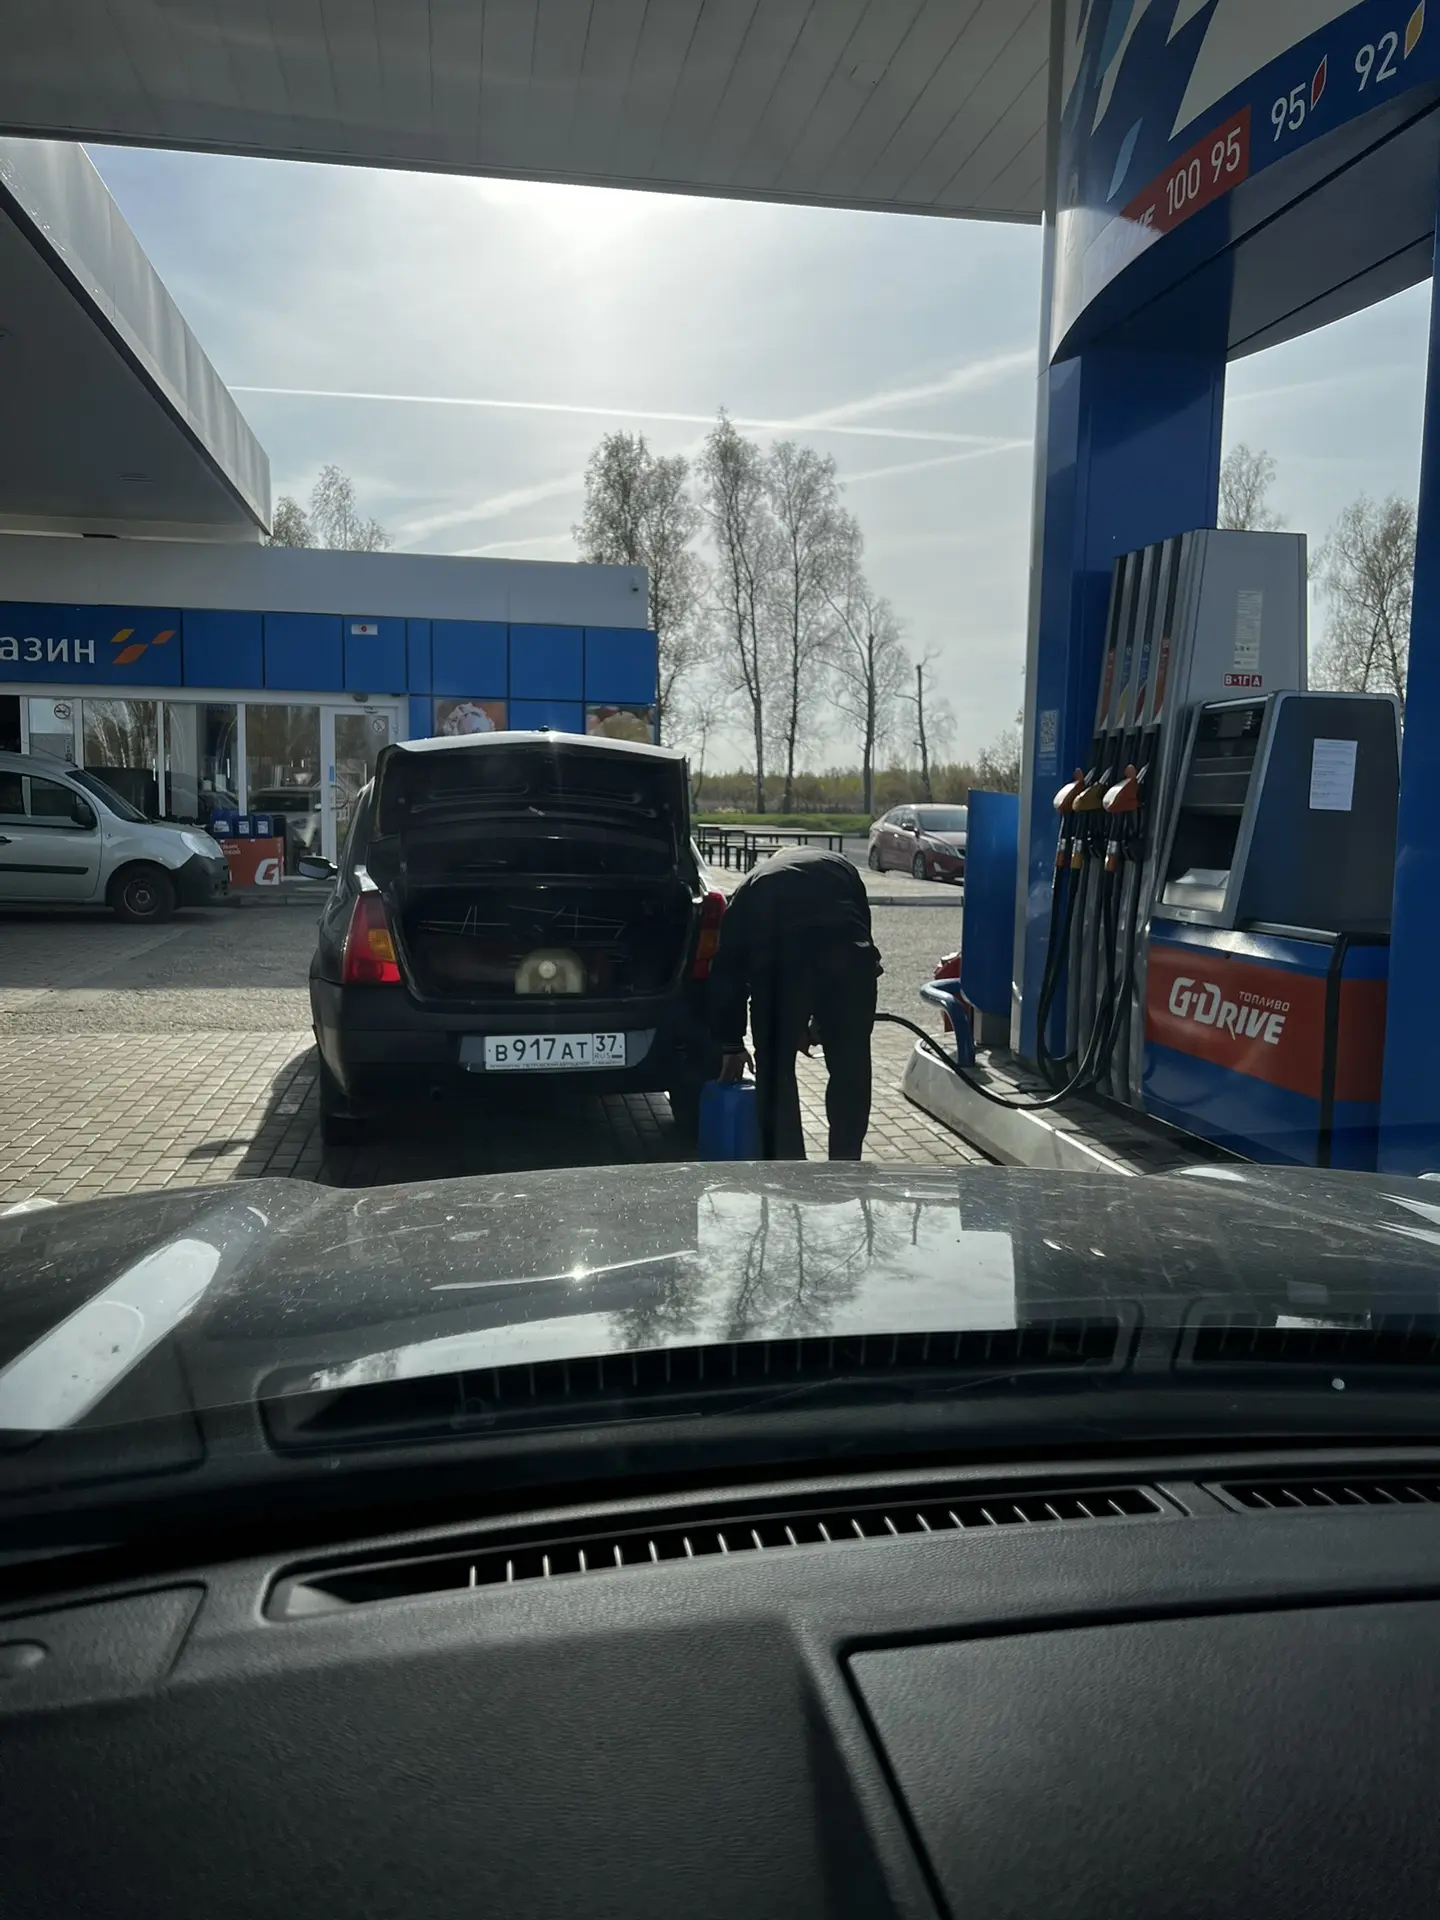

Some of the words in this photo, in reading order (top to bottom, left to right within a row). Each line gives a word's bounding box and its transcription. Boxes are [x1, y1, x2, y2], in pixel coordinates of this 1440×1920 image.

[1166, 158, 1201, 216] 100
[1210, 126, 1242, 184] 95
[1270, 82, 1307, 142] 95
[1354, 31, 1399, 92] 92
[1239, 991, 1290, 1012] ТОПЛИВО
[596, 1035, 617, 1052] 37
